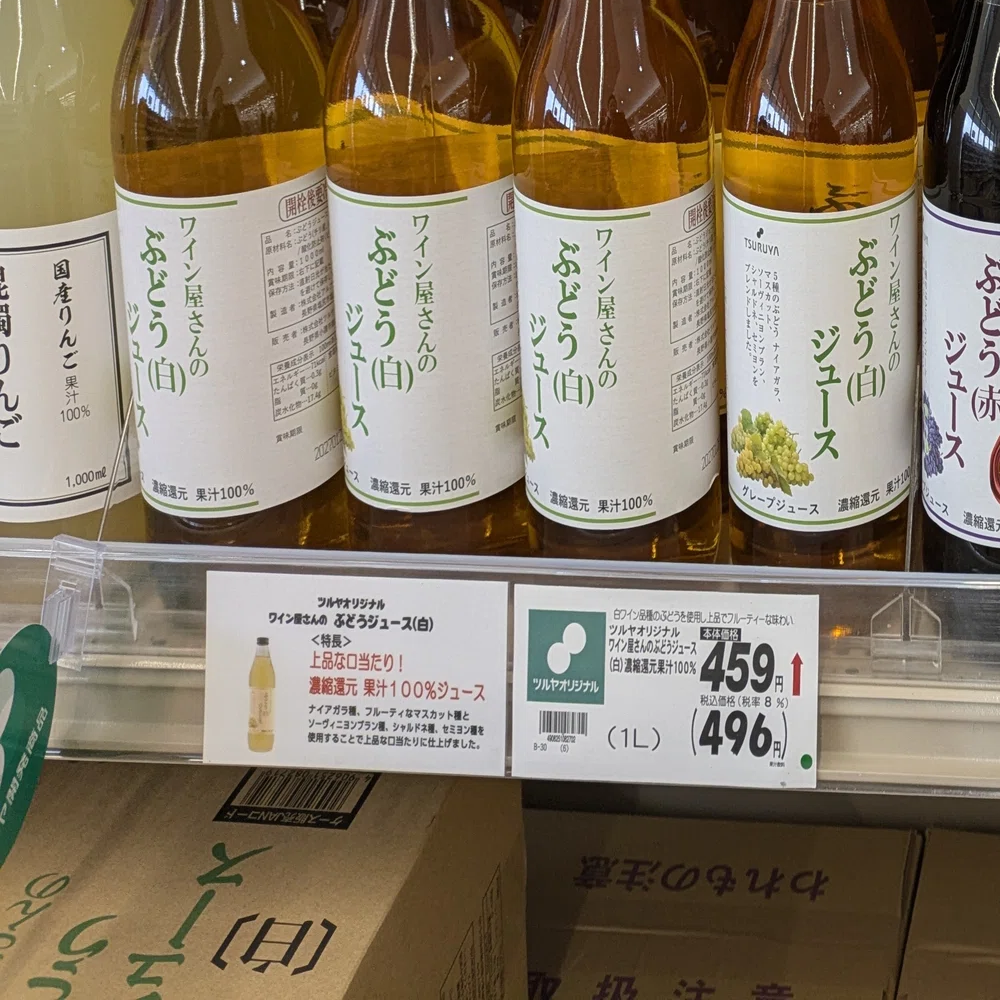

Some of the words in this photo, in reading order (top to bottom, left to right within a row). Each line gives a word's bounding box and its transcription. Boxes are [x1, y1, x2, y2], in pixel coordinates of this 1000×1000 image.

[179, 216, 209, 378] ワイン屋さんの
[412, 213, 437, 374] ワイン屋さんの
[888, 212, 901, 372] ワイン屋さんの
[53, 258, 79, 370] 国産りんご
[595, 227, 618, 390] ワイン屋さんの
[345, 302, 370, 437] ジュース
[530, 312, 550, 450] ジュース
[810, 324, 842, 461] ジュース
[943, 329, 968, 469] ジュース
[59, 404, 91, 423] 100%
[196, 483, 255, 503] 果汁100%
[420, 473, 476, 497] 果汁100%
[597, 493, 653, 514] 果汁100%
[742, 483, 820, 516] グレープジュース
[317, 596, 386, 612] ツルヤオリジナル
[268, 612, 328, 626] ワイン屋さんの
[333, 614, 434, 633] ぶどうジュース(白)
[609, 624, 680, 638] ツルヤオリジナル
[702, 627, 739, 641] 本体価格
[608, 638, 698, 656] ワイン屋さんのぶどうジュース
[308, 675, 358, 697] 濃縮還元
[532, 677, 600, 694] ツルヤオリジナル
[307, 732, 481, 751] 使用することで上品な口当たりに仕上げました。
[573, 854, 830, 902] われもの注意
